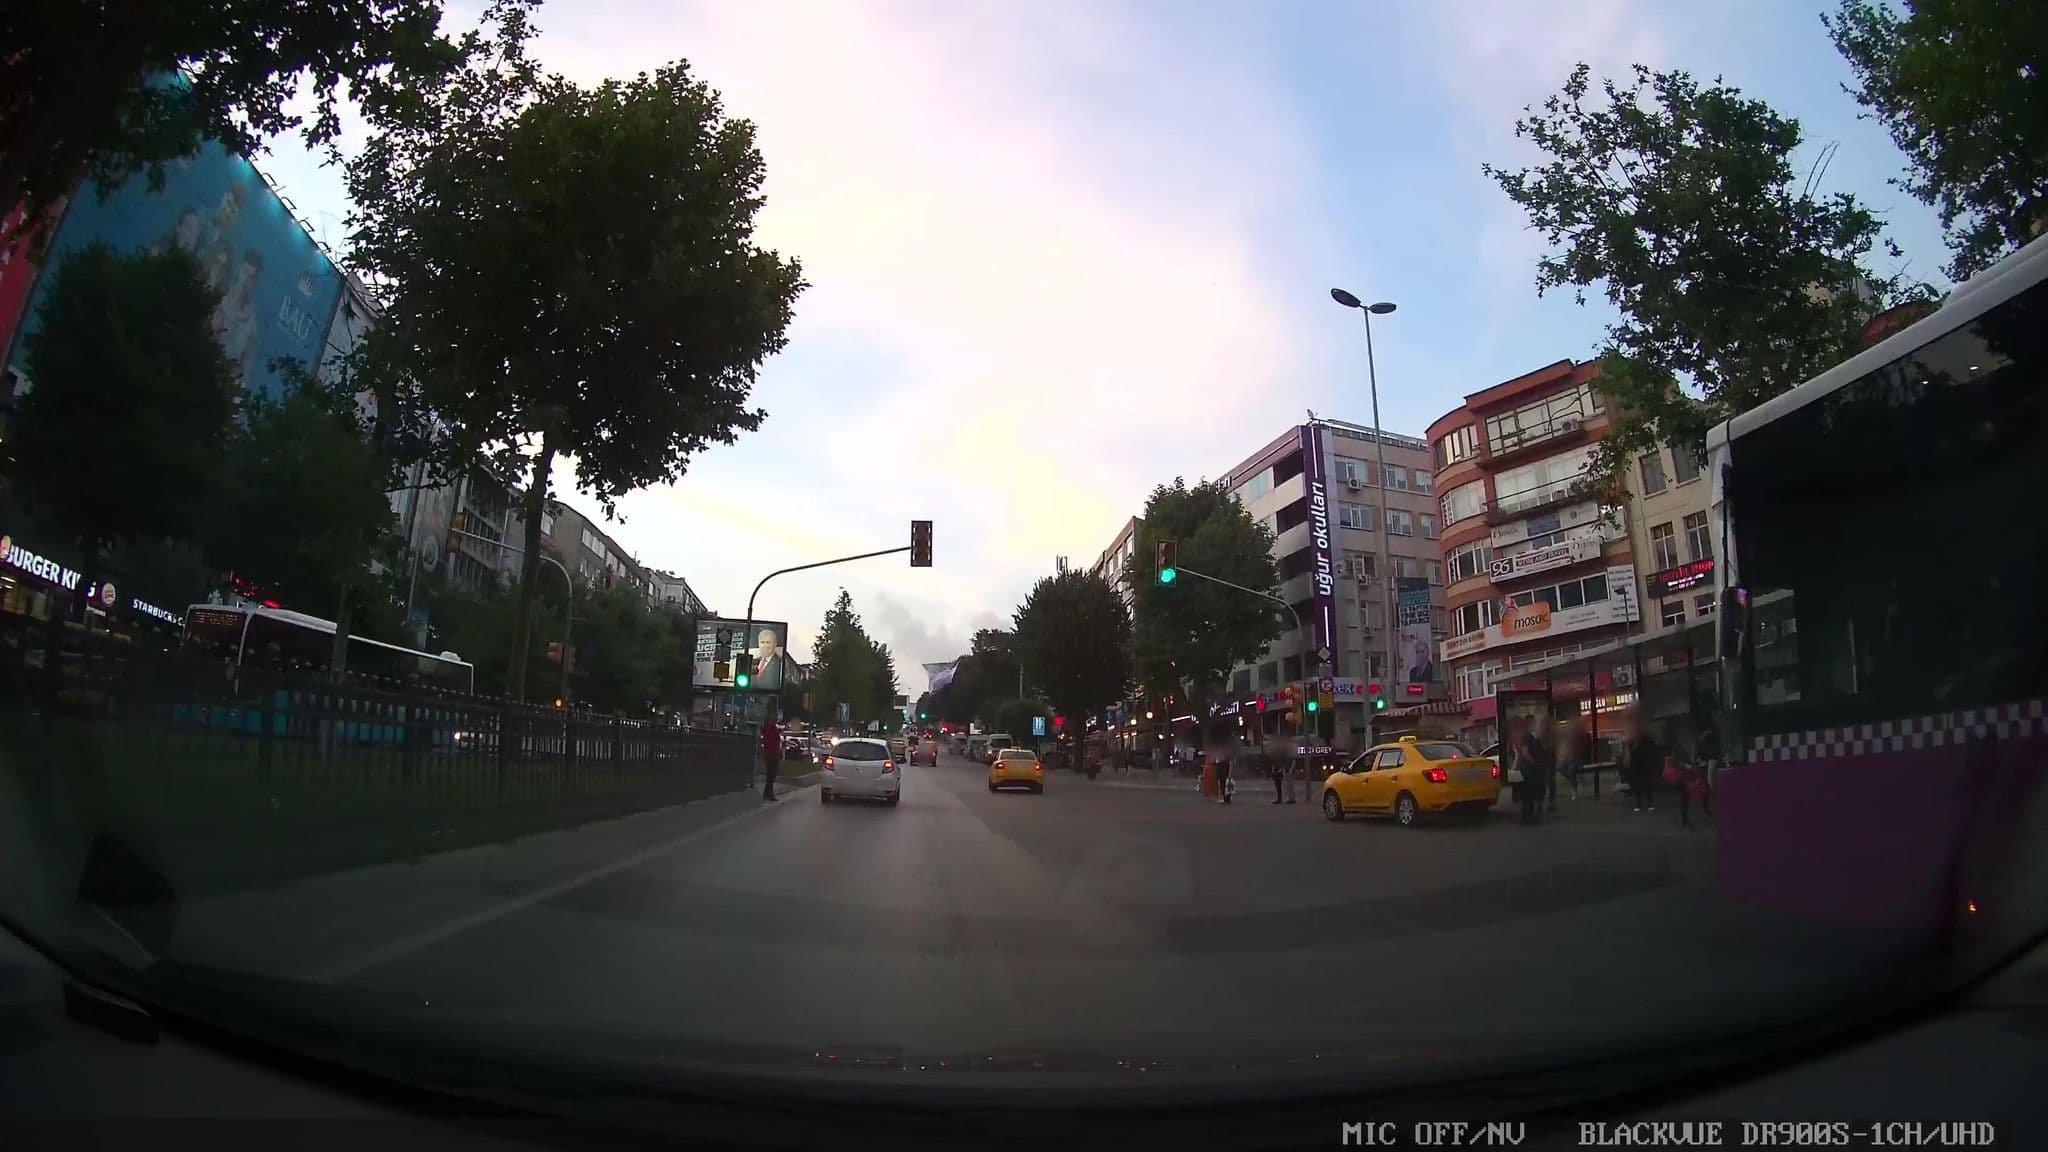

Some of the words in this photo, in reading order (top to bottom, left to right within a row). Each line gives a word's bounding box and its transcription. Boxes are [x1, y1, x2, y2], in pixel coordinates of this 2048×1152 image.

[1310, 481, 1329, 549] okulları
[1315, 552, 1333, 597] uğur
[132, 598, 177, 623] STARBUCKS
[1514, 612, 1549, 630] mosaic
